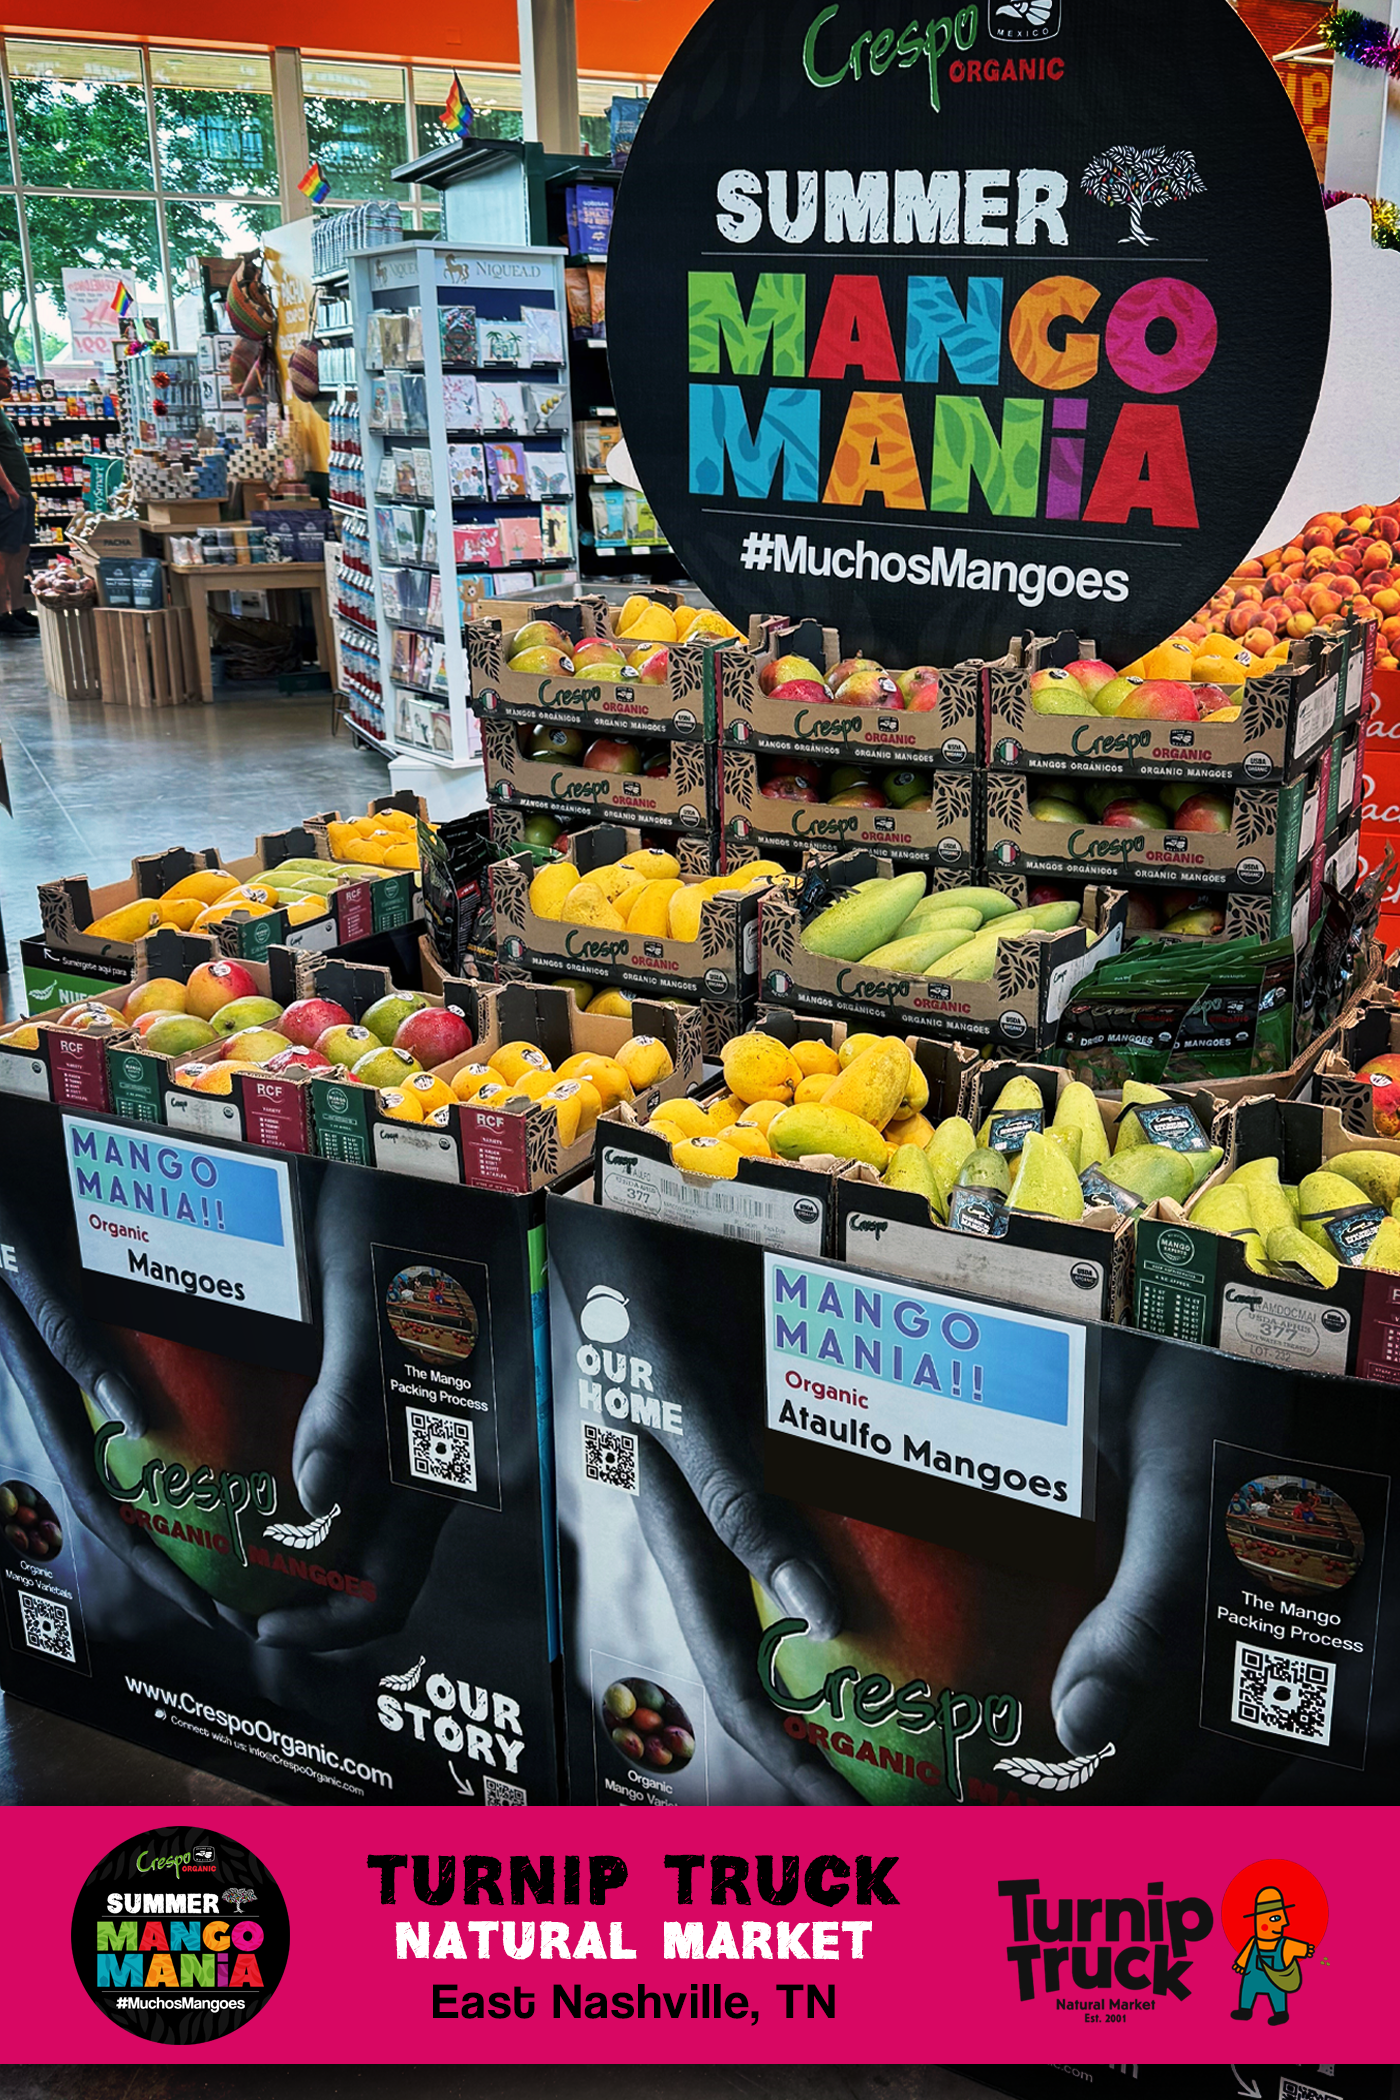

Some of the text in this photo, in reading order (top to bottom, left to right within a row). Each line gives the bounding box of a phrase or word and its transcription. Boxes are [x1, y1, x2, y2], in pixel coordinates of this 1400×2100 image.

[997, 27, 1049, 37] MEXICO
[803, 3, 978, 113] Crespo
[949, 57, 1065, 83] ORGANIC
[716, 168, 1068, 246] SUMMER
[687, 270, 1218, 394] MANGO
[740, 531, 1131, 608] #MuchosMangoes
[538, 679, 600, 718] Crespo
[603, 702, 649, 715] ORGANIC
[794, 709, 862, 748] Crespo
[865, 732, 916, 745] ORGANIC
[759, 740, 791, 750] MANGOS
[855, 749, 934, 762] ORGANIC MANGOES
[1072, 724, 1151, 767] Crespo
[1152, 747, 1212, 761] ORGANIC
[1029, 760, 1066, 770] MANGOS
[1141, 766, 1233, 778] ORGANIC MANGOES
[550, 773, 609, 810] Crespo
[613, 795, 656, 808] ORGANIC
[792, 810, 858, 846] Crespo
[861, 831, 911, 843] ORGANIC
[1067, 829, 1144, 871] Crespo
[1146, 850, 1204, 864] ORGANIC
[1027, 862, 1063, 871] MANGOS
[1135, 870, 1226, 883] ORGANIC MANGOES
[532, 957, 563, 969] MANGOS
[566, 929, 629, 970] Crespo
[632, 955, 679, 971] ORGANIC
[623, 972, 697, 992] ORGANIC MANGOES
[836, 968, 909, 1014] Crespo
[798, 994, 832, 1007] MANGOS
[914, 998, 971, 1013] ORGANIC
[902, 1014, 990, 1034] ORGANIC MANGOES
[1107, 1034, 1154, 1044] MANGOES
[60, 1040, 83, 1053] RCF
[1184, 1038, 1231, 1048] MANGOES
[257, 1083, 283, 1097] RCF
[476, 1113, 504, 1127] RCF
[72, 1127, 218, 1189] MANGO
[77, 1167, 226, 1230] MANIA!!
[627, 1188, 651, 1204] 377
[88, 1213, 150, 1244] Organic
[1161, 1238, 1191, 1252] MANGO
[127, 1247, 246, 1302] Mangoes
[775, 1267, 981, 1352] MANGO
[1260, 1323, 1298, 1342] 377
[576, 1343, 654, 1392] OUR
[775, 1315, 984, 1402] MANIA!!
[404, 1364, 472, 1391] The Mango
[785, 1370, 869, 1411] Organic
[390, 1379, 489, 1412] Packing Process
[577, 1379, 684, 1436] HOME
[779, 1398, 1068, 1503] Ataulfo Mangoes
[94, 1421, 278, 1566] Crespo
[118, 1503, 377, 1603] ORGANIC MANGOES
[5, 1569, 74, 1600] Mango Varietals
[20, 1560, 54, 1579] Organic
[1241, 1590, 1341, 1627] The Mango
[1217, 1605, 1364, 1653] Packing Process
[425, 1672, 523, 1737] OUR
[758, 1618, 1023, 1802] Crespo
[125, 1674, 393, 1789] www.CrespoOrganic.com
[377, 1694, 524, 1774] STORY
[171, 1715, 364, 1797] Connect with us: info@CrespoOrganic.com
[783, 1715, 942, 1787] ORGANIC
[605, 1778, 645, 1802] Mango
[627, 1769, 674, 1794] Organic
